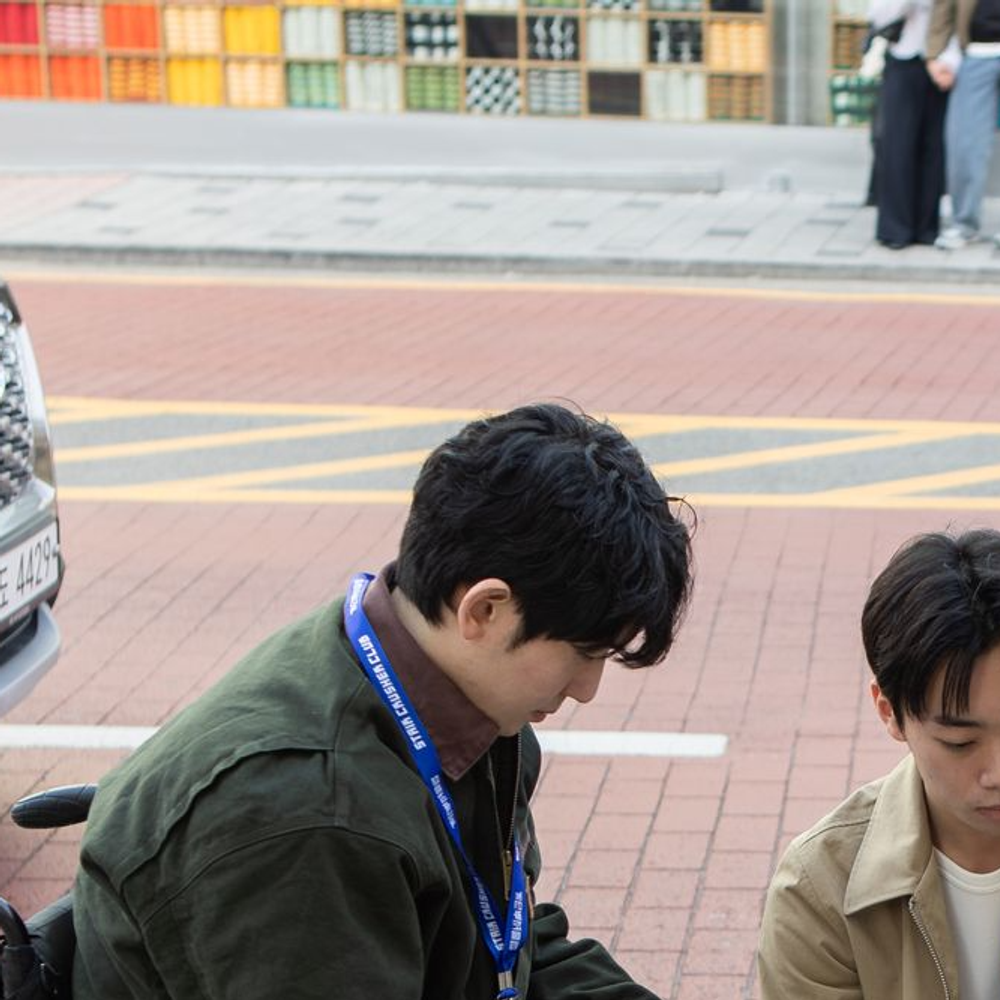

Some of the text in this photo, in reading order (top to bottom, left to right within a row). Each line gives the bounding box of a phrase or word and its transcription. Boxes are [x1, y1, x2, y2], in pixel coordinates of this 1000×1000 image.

[16, 535, 51, 596] 4429
[358, 634, 427, 751] STAIR CRUSHER CLUB
